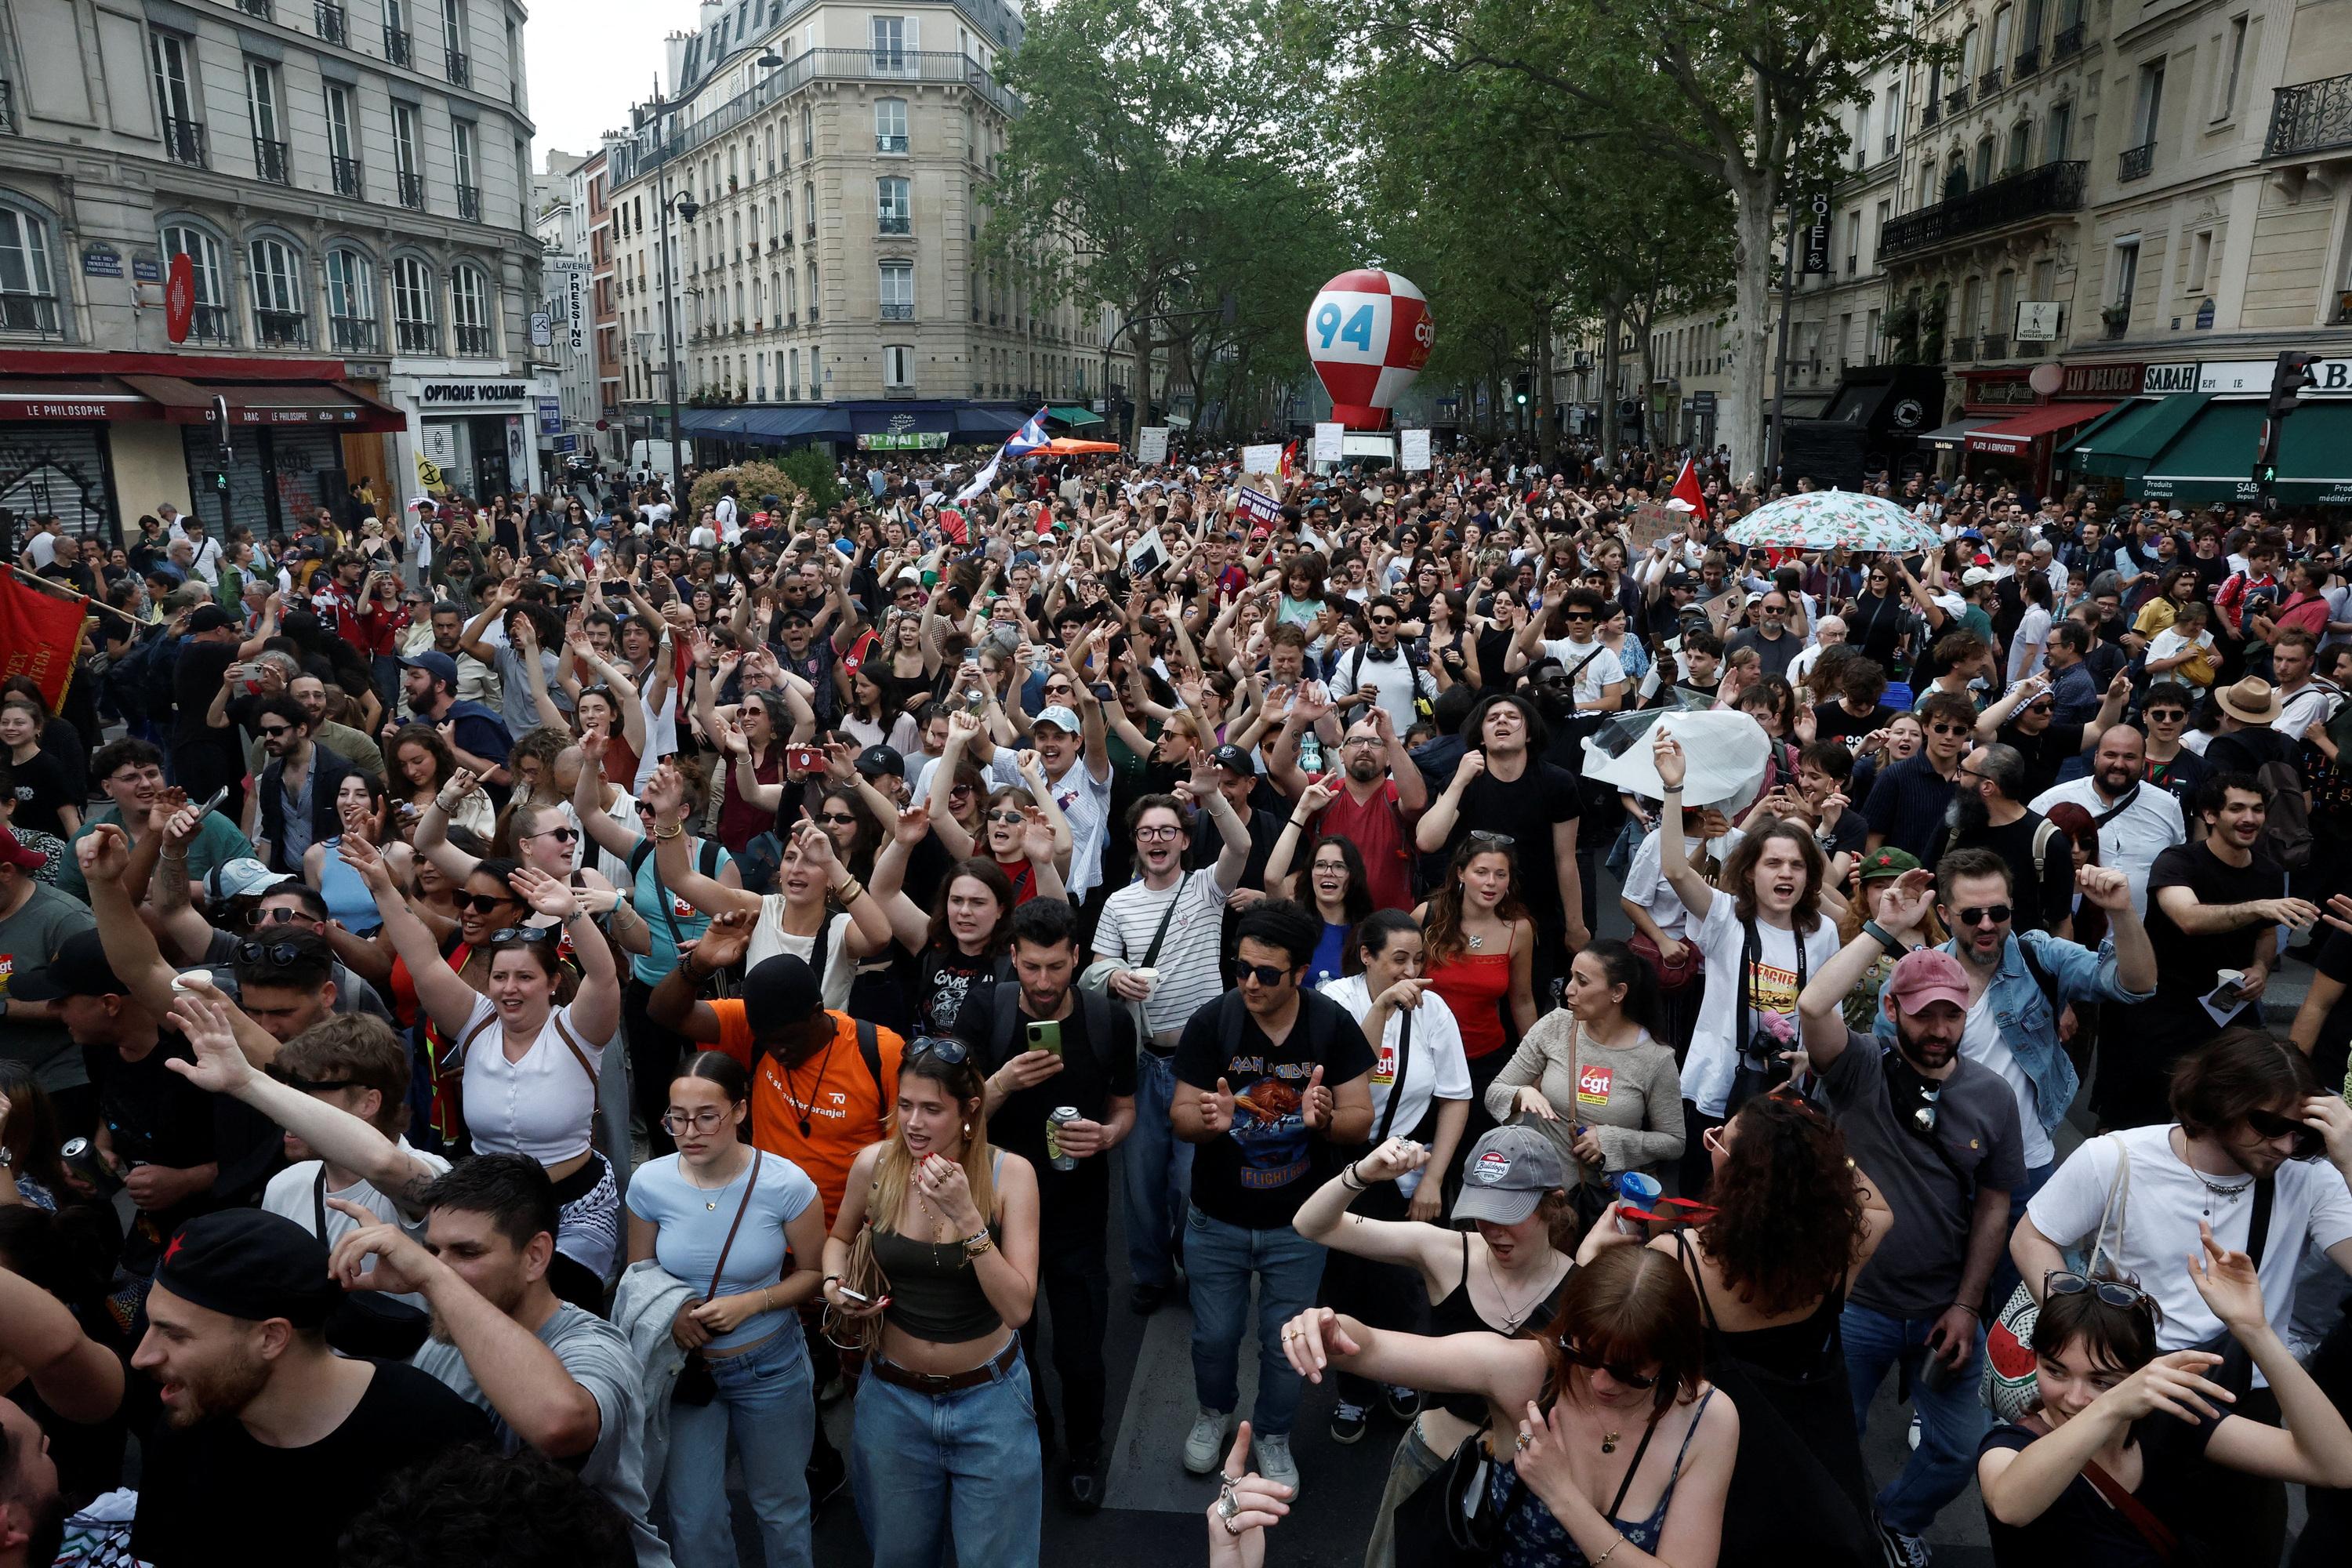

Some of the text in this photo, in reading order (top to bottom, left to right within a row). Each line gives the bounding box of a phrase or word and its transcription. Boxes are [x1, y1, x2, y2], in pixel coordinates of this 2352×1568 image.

[556, 262, 593, 270] LAVERIE
[570, 273, 582, 347] PRESSING
[1316, 303, 1374, 351] 94
[2087, 367, 2136, 390] DELICES
[2145, 367, 2195, 390] SABAH
[424, 385, 526, 401] OPTIQUE VOLTAIRE
[27, 405, 107, 416] LE PHILOSOPHE
[271, 412, 308, 421] LE PHILOSOPHE
[885, 435, 911, 445] MAI
[2237, 483, 2259, 492] SAB
[1242, 488, 1279, 510] PAS TOUCHE AU
[1250, 503, 1270, 520] MAI
[845, 657, 858, 666] cgt
[675, 898, 692, 910] cg
[0, 960, 12, 974] gt
[1377, 1056, 1393, 1074] gt
[1581, 1076, 1610, 1094] cgt
[766, 1070, 773, 1081] Ik
[811, 1106, 847, 1119] oranje!
[1476, 1161, 1505, 1172] Bulldogs
[1247, 1167, 1287, 1185] FLIGHT
